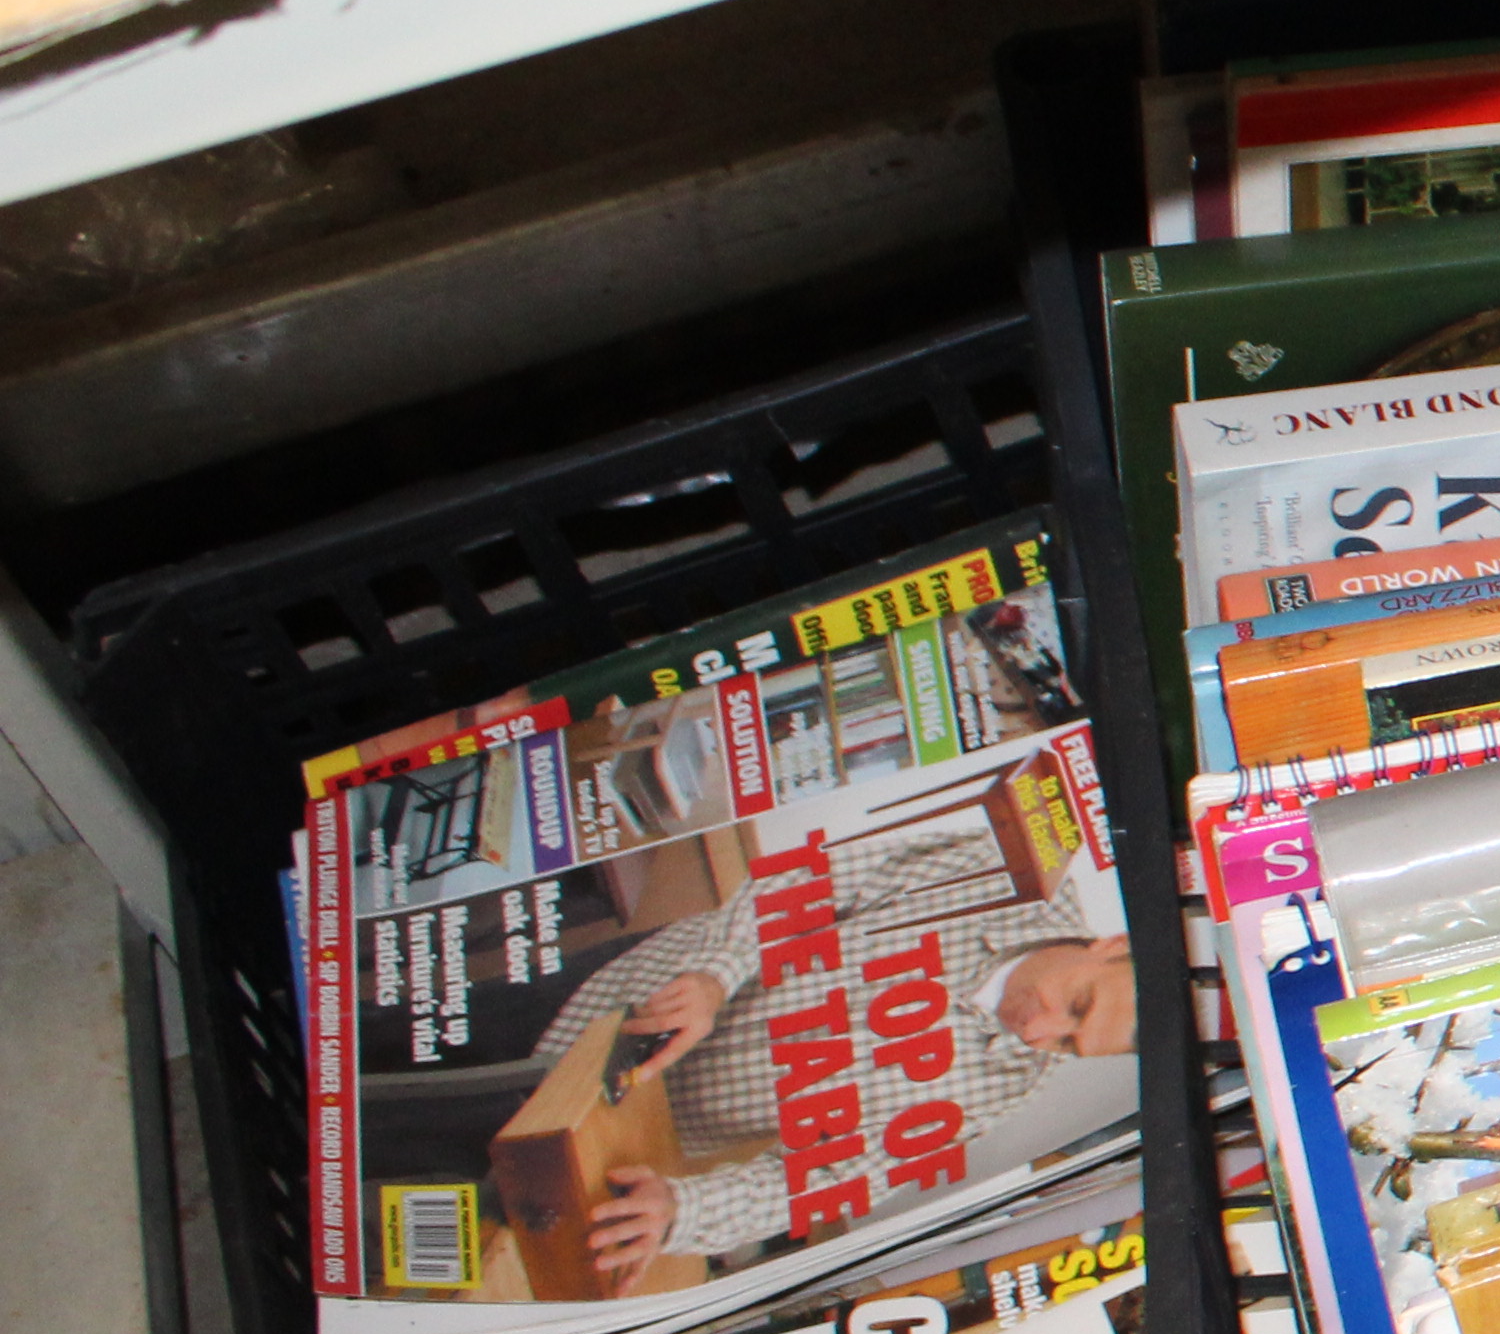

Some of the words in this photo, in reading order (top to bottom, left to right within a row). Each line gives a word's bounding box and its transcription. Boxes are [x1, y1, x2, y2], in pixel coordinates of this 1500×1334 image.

[1270, 395, 1415, 438] BLANC
[1337, 562, 1461, 597] WORLD
[908, 634, 945, 747] SHELVING
[724, 685, 763, 801] SOLUTION
[1061, 728, 1097, 793] FREE
[312, 798, 337, 855] TRITON
[528, 741, 562, 856] ROUNDUP
[314, 850, 339, 912] PLUNGE
[499, 886, 527, 935] oak
[533, 876, 561, 946] Make
[747, 825, 840, 994] THE
[316, 907, 340, 950] DRILL
[434, 902, 471, 1019] Measuring
[504, 930, 531, 990] door
[539, 942, 562, 978] an
[318, 955, 341, 987] SIP
[372, 916, 402, 1011] statistics
[405, 908, 439, 1017] furniture's
[445, 1015, 469, 1049] up
[861, 926, 956, 1099] TOP
[318, 1035, 343, 1097] SANDER
[319, 1102, 343, 1162] RECORD
[765, 982, 868, 1245] TABLE
[883, 1090, 966, 1202] OF
[321, 1157, 344, 1228] BANDSAW
